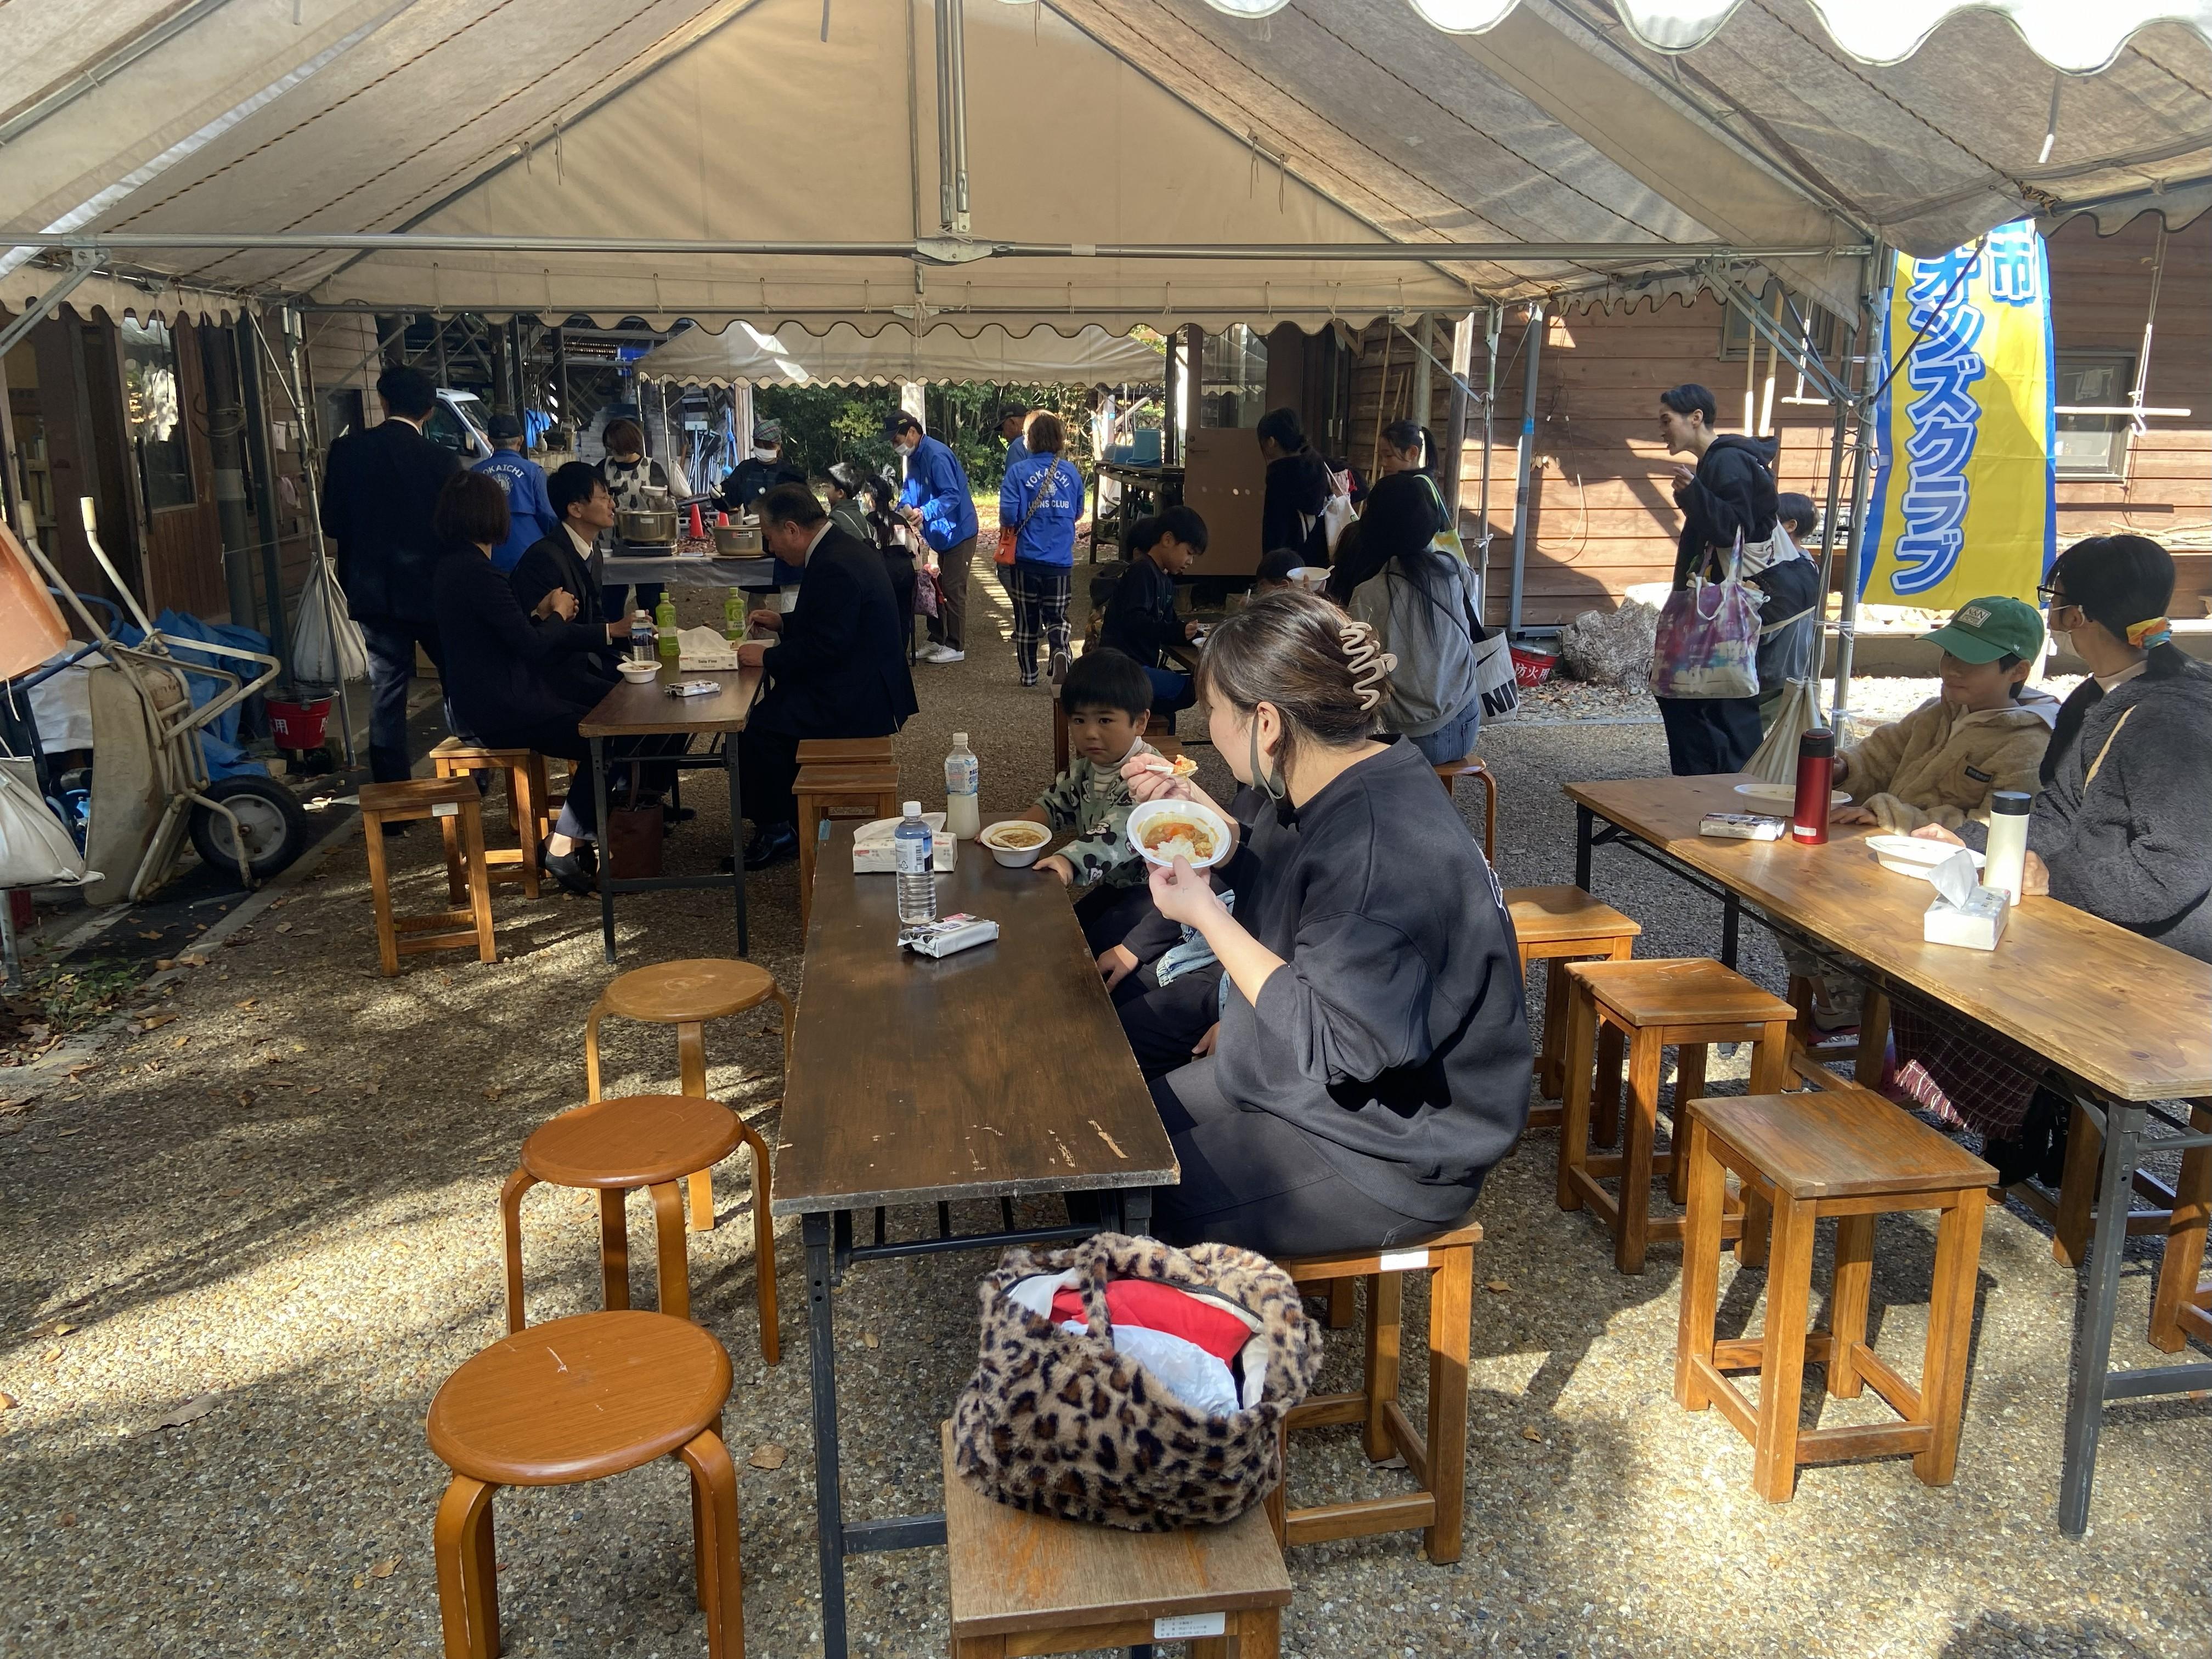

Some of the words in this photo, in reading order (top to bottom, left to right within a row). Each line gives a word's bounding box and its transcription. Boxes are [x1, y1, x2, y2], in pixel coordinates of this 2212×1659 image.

[1025, 468, 1070, 488] YOKACHI
[1028, 500, 1050, 509] LINS
[1051, 500, 1069, 509] CLUB
[1515, 662, 1550, 680] 防火用
